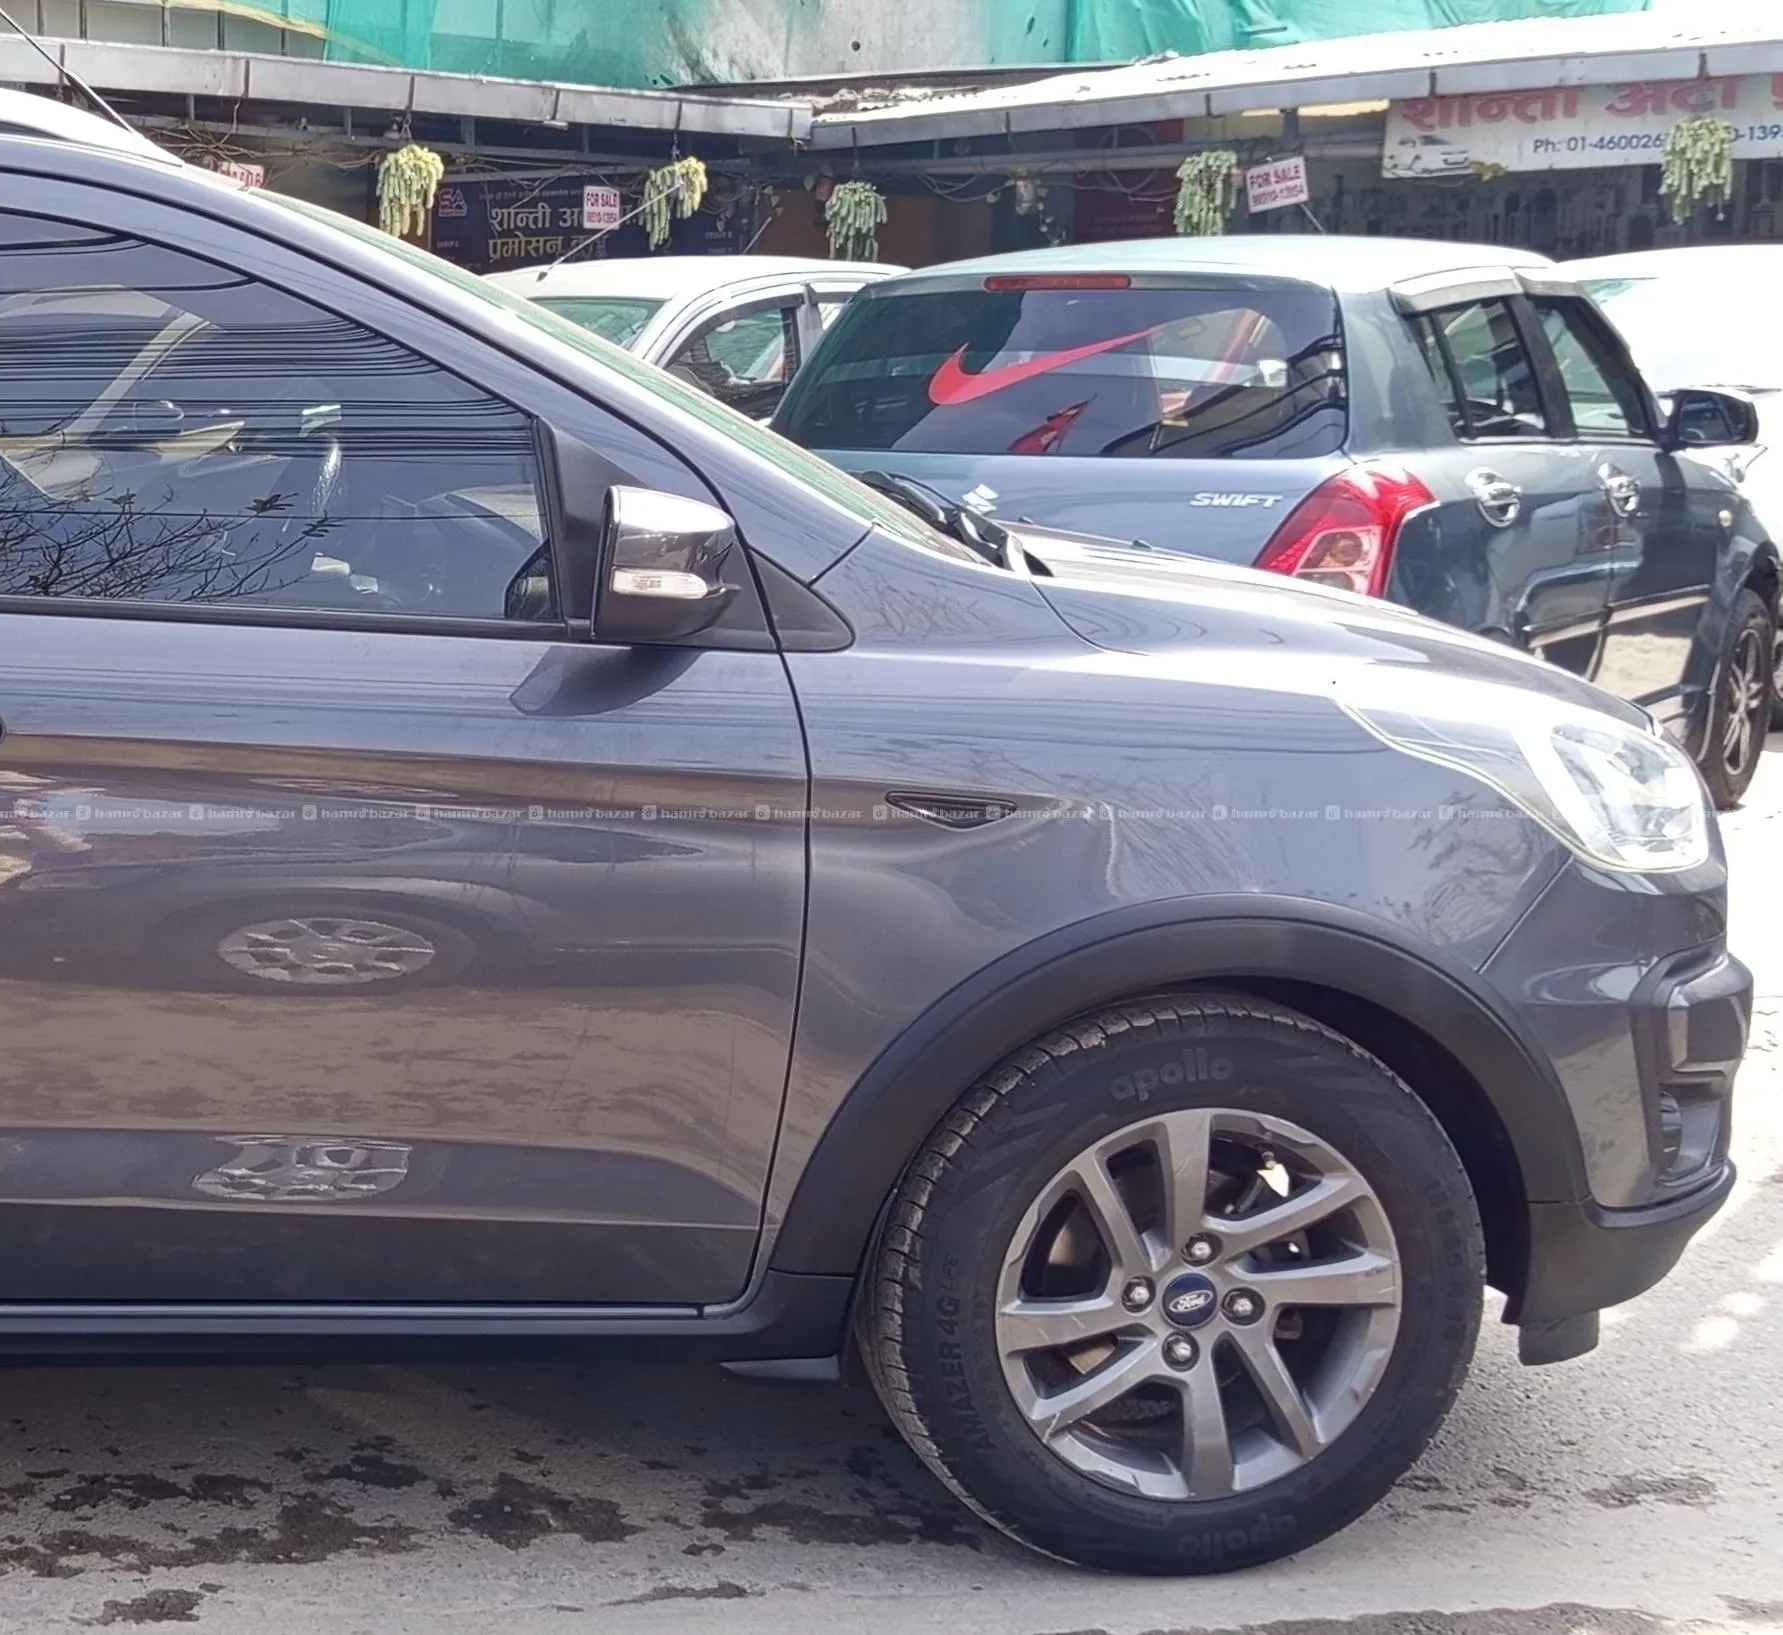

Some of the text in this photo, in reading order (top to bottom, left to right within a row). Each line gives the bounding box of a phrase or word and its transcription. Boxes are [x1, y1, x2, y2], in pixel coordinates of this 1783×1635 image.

[1567, 133, 1669, 152] 01-460026
[1249, 164, 1301, 189] FOR SALE
[586, 192, 601, 207] FOR
[601, 193, 617, 207] SALE
[490, 202, 552, 231] शान्ती
[1190, 491, 1283, 508] SWIFT
[1109, 1047, 1234, 1102] apollo
[942, 1253, 960, 1291] LIFE
[936, 1296, 961, 1336] 4G
[938, 1342, 998, 1449] AMAZER
[1176, 1512, 1297, 1563] apollo
